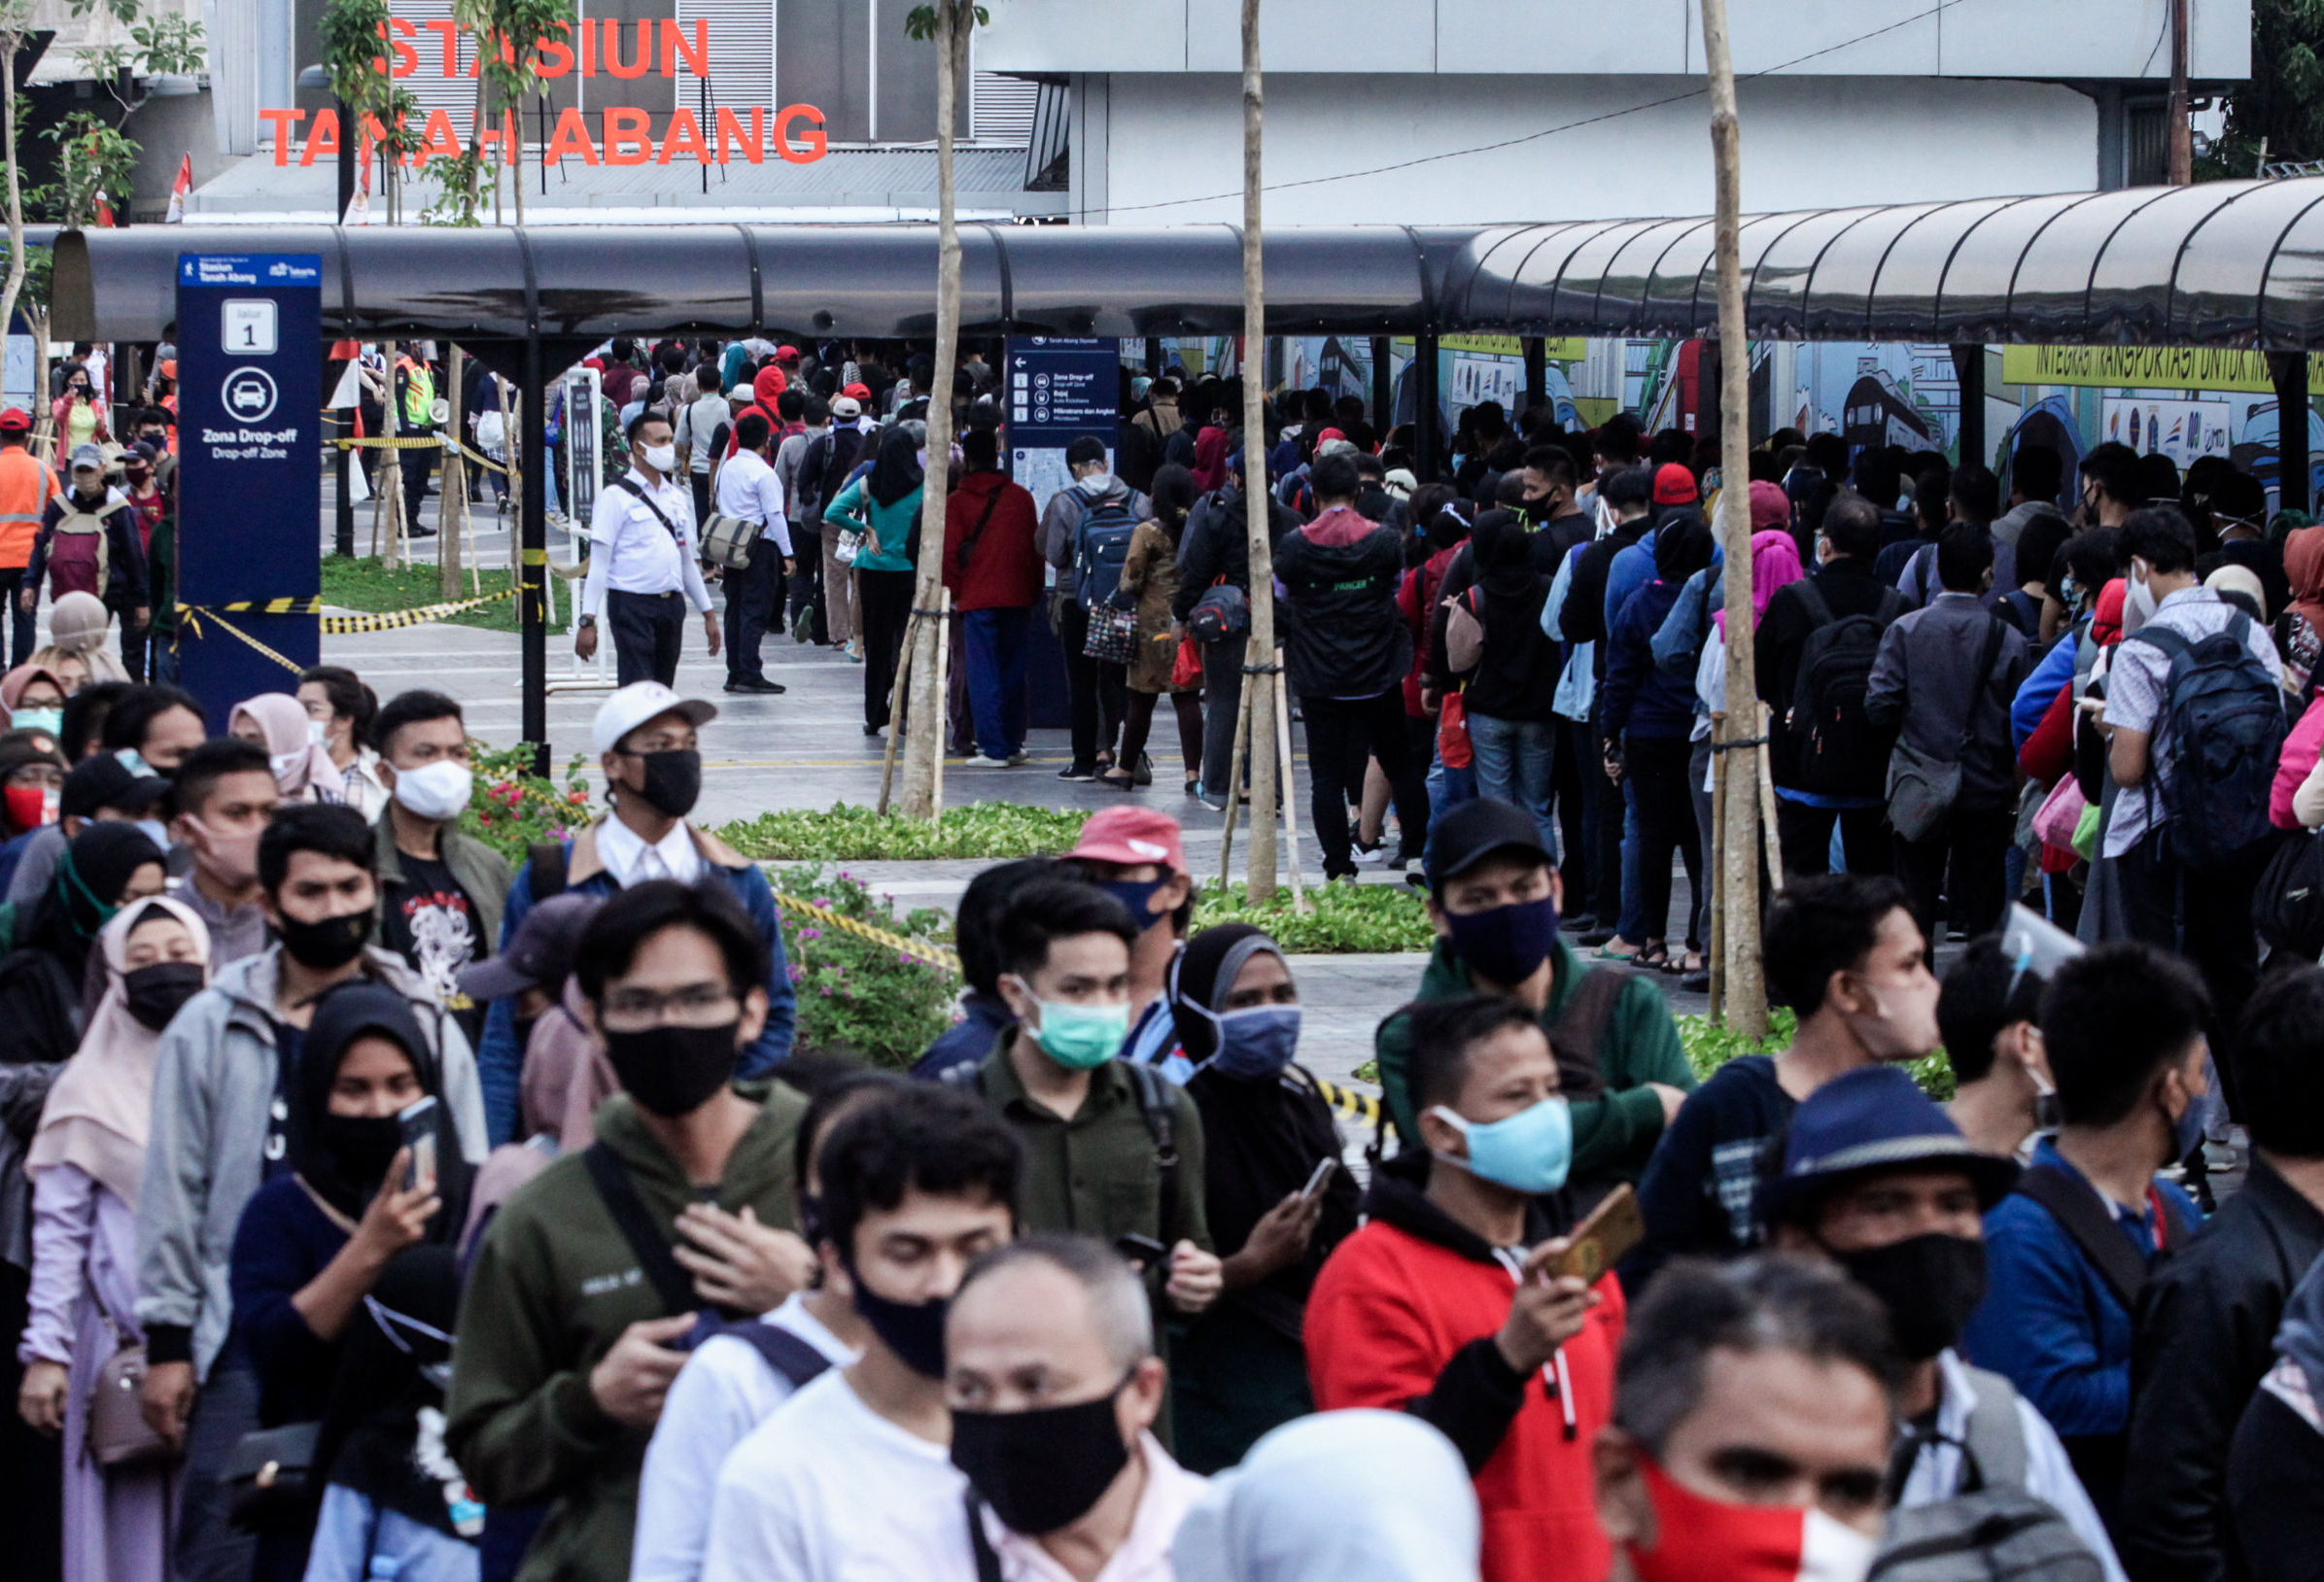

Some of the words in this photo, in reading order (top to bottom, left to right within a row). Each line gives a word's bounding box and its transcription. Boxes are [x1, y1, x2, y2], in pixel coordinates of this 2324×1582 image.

[259, 108, 517, 168] TANAH
[544, 103, 827, 166] ABANG
[198, 272, 227, 283] Tanah
[227, 272, 257, 285] Abang
[243, 324, 257, 346] 1
[201, 428, 237, 443] Zona
[238, 428, 297, 446] Drop-off
[211, 447, 259, 462] Drop-off
[260, 447, 288, 460] Zone
